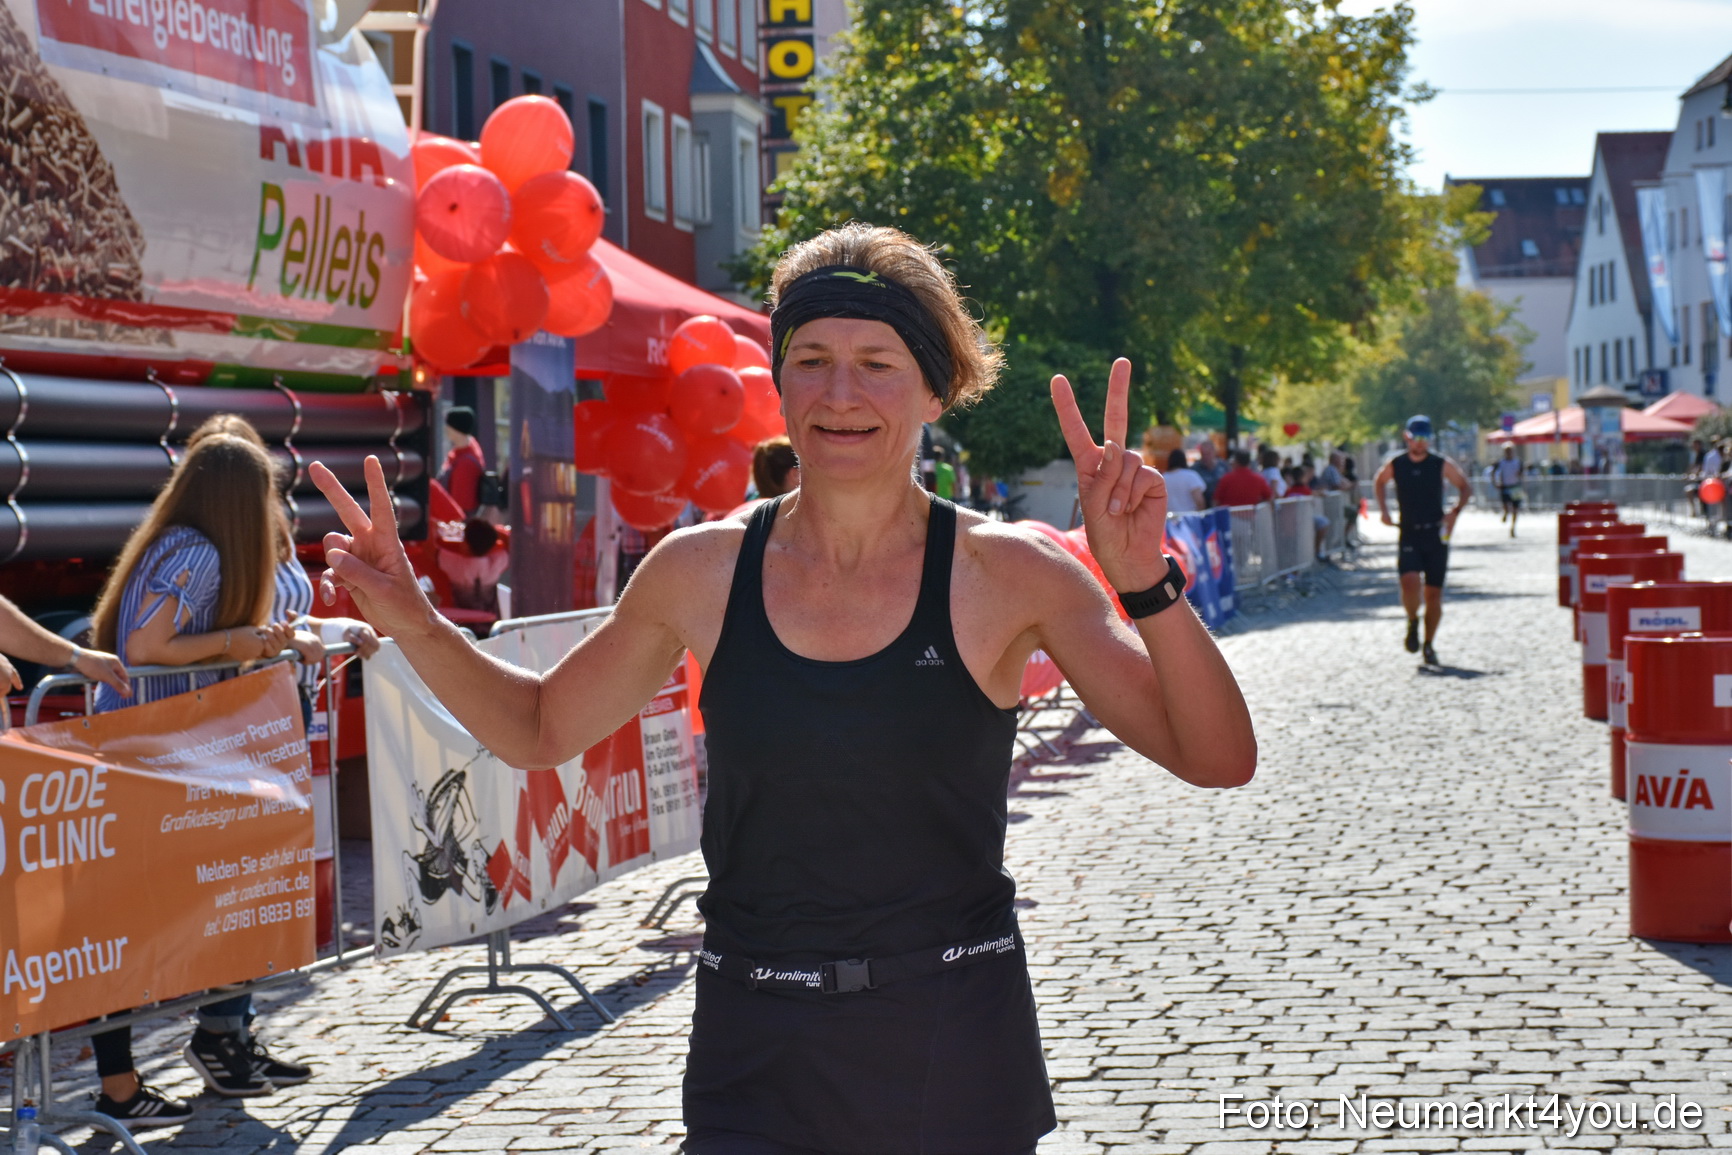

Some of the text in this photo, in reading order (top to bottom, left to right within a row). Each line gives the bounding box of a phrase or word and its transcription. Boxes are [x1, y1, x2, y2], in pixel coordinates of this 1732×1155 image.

[248, 182, 385, 309] Pellets
[248, 715, 293, 740] Partner
[251, 738, 307, 769] Umsetzu
[19, 766, 108, 818] CODE
[238, 802, 258, 820] und
[19, 813, 117, 873] CLINIC
[196, 860, 239, 884] Melden
[241, 856, 258, 875] Sie
[260, 849, 279, 871] sich
[222, 908, 257, 932] 09181
[258, 902, 292, 924] 8833
[967, 932, 1015, 956] unlimited
[996, 943, 1016, 954] running
[4, 936, 128, 1004] Agentur
